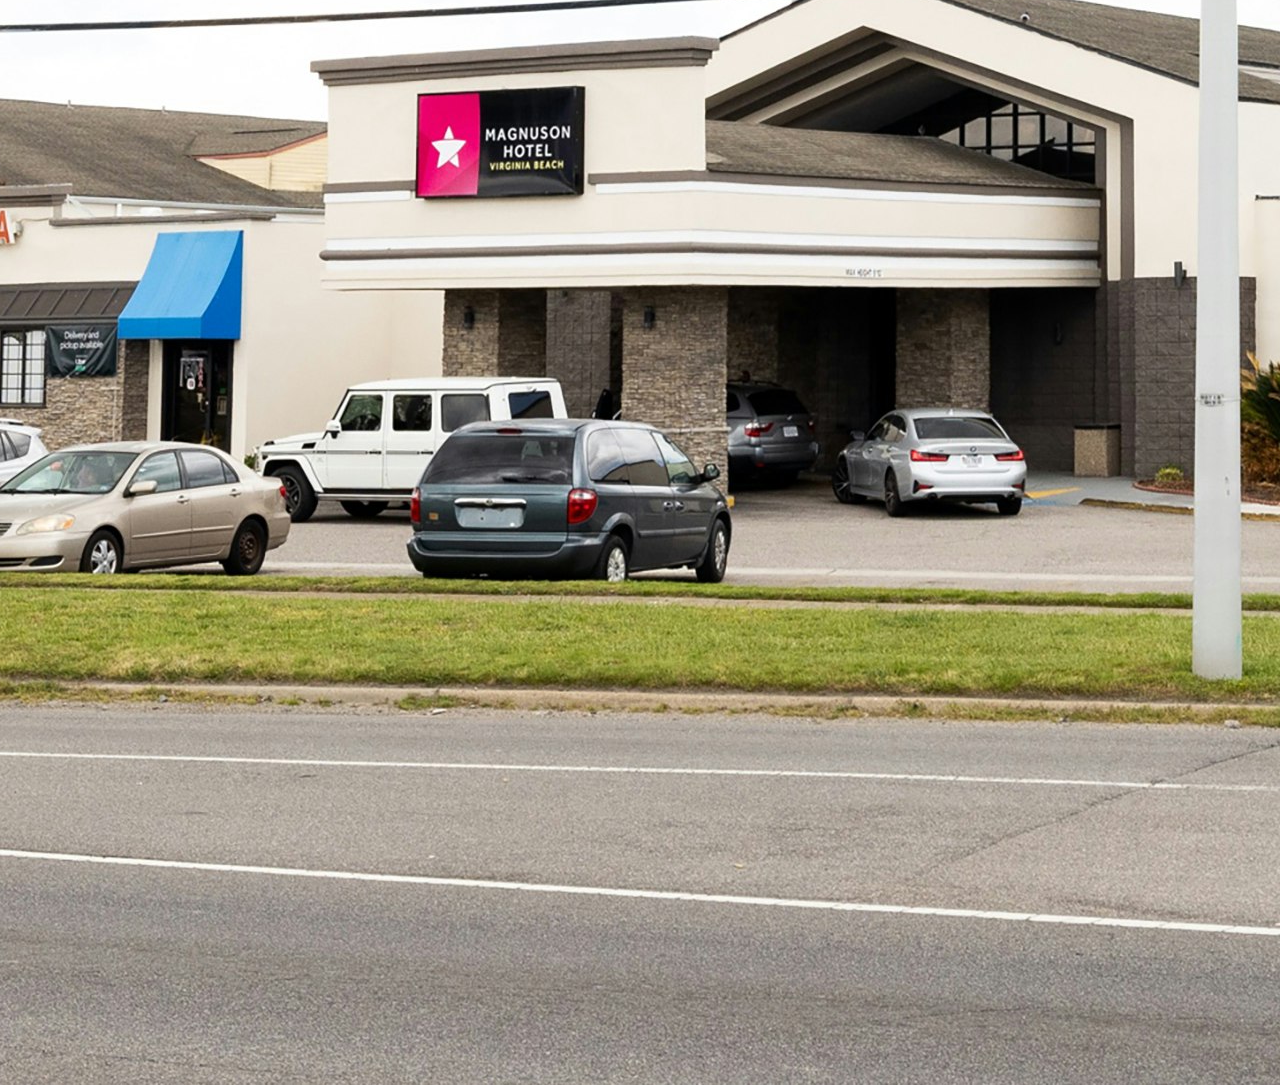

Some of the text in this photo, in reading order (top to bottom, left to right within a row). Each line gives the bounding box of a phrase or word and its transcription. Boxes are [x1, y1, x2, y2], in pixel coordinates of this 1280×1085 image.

[485, 125, 571, 142] MAGNUSON
[503, 144, 552, 158] HOTEL
[489, 160, 564, 171] VIRGINIA BEACH
[64, 331, 99, 341] Delivery and
[60, 341, 79, 350] pickup
